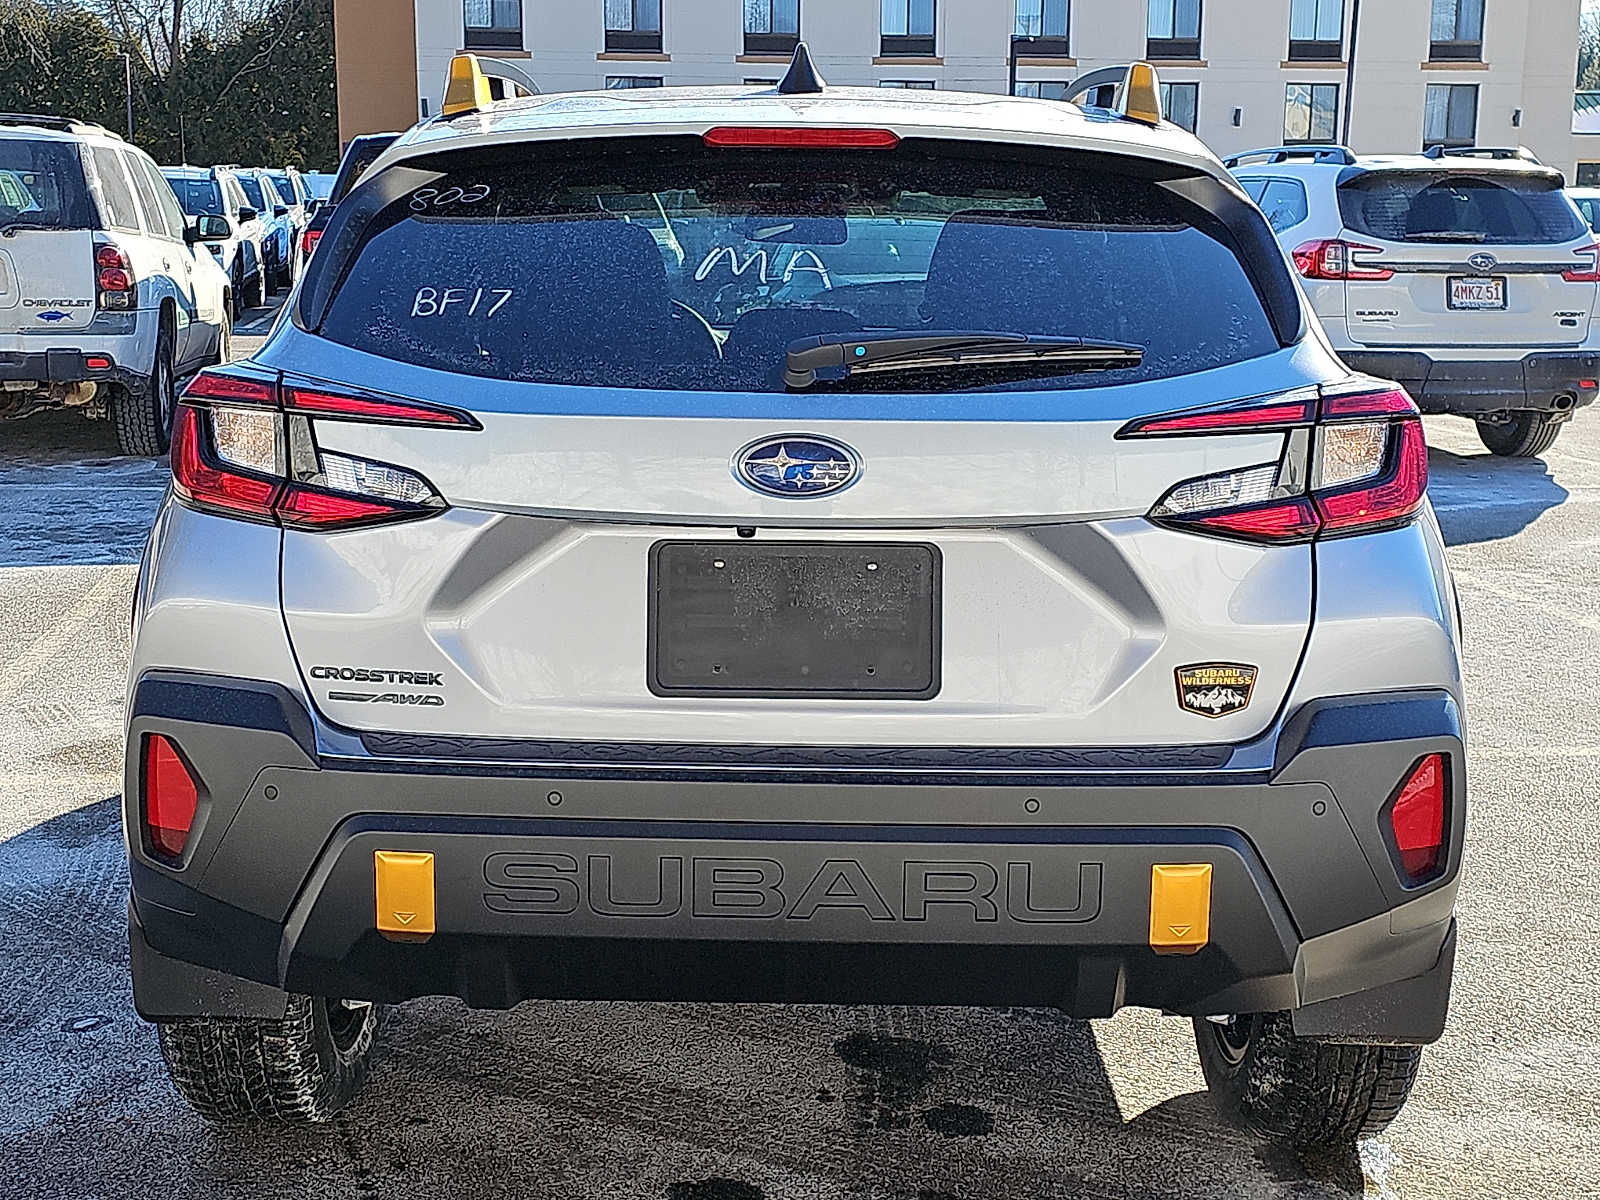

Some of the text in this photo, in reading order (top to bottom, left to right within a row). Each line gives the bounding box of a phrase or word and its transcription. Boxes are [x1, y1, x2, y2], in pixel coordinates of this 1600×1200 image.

[409, 184, 490, 210] 802
[694, 246, 832, 291] MA
[1453, 285, 1501, 300] 4MKZ 51
[22, 299, 93, 307] CHEVROLET
[411, 287, 513, 317] BF17
[310, 666, 444, 686] CROSSTREK
[1182, 676, 1252, 685] WILDERNESS
[1194, 668, 1240, 678] SUBARU
[371, 693, 445, 706] AWD
[482, 851, 1104, 924] SUBARU
